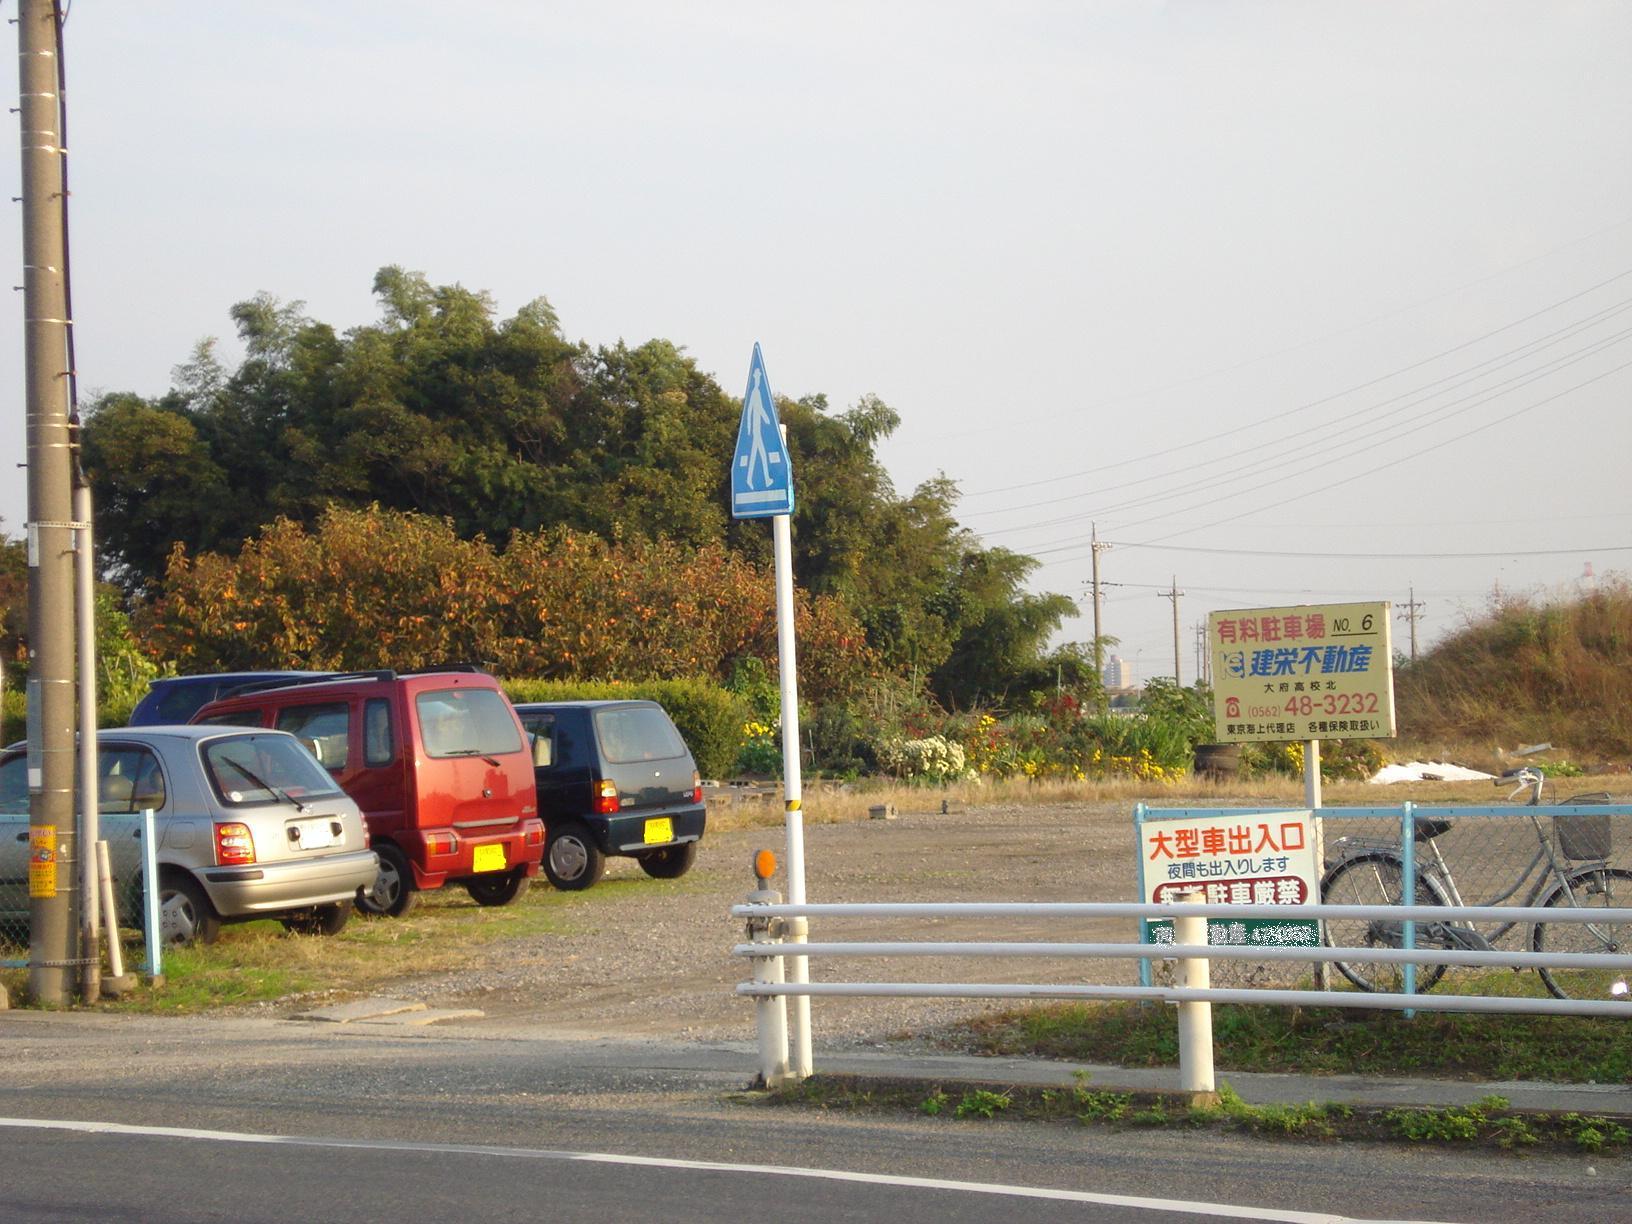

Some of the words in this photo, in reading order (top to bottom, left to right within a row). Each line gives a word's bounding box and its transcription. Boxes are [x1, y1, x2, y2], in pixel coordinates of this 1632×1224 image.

[1217, 614, 1326, 644] 有料駐車場
[1333, 618, 1351, 633] NO.
[1361, 614, 1373, 631] 6
[1249, 644, 1373, 677] 建栄不動産
[1264, 681, 1337, 694] 大府高校北
[1248, 705, 1281, 719] (0562)
[1284, 692, 1379, 717] 48-3232
[1227, 722, 1296, 735] 東京海上代理店
[1308, 719, 1380, 733] 各種保険取扱い
[1149, 822, 1305, 861] 大型車出入口
[1167, 856, 1290, 880] 夜間も出入りします
